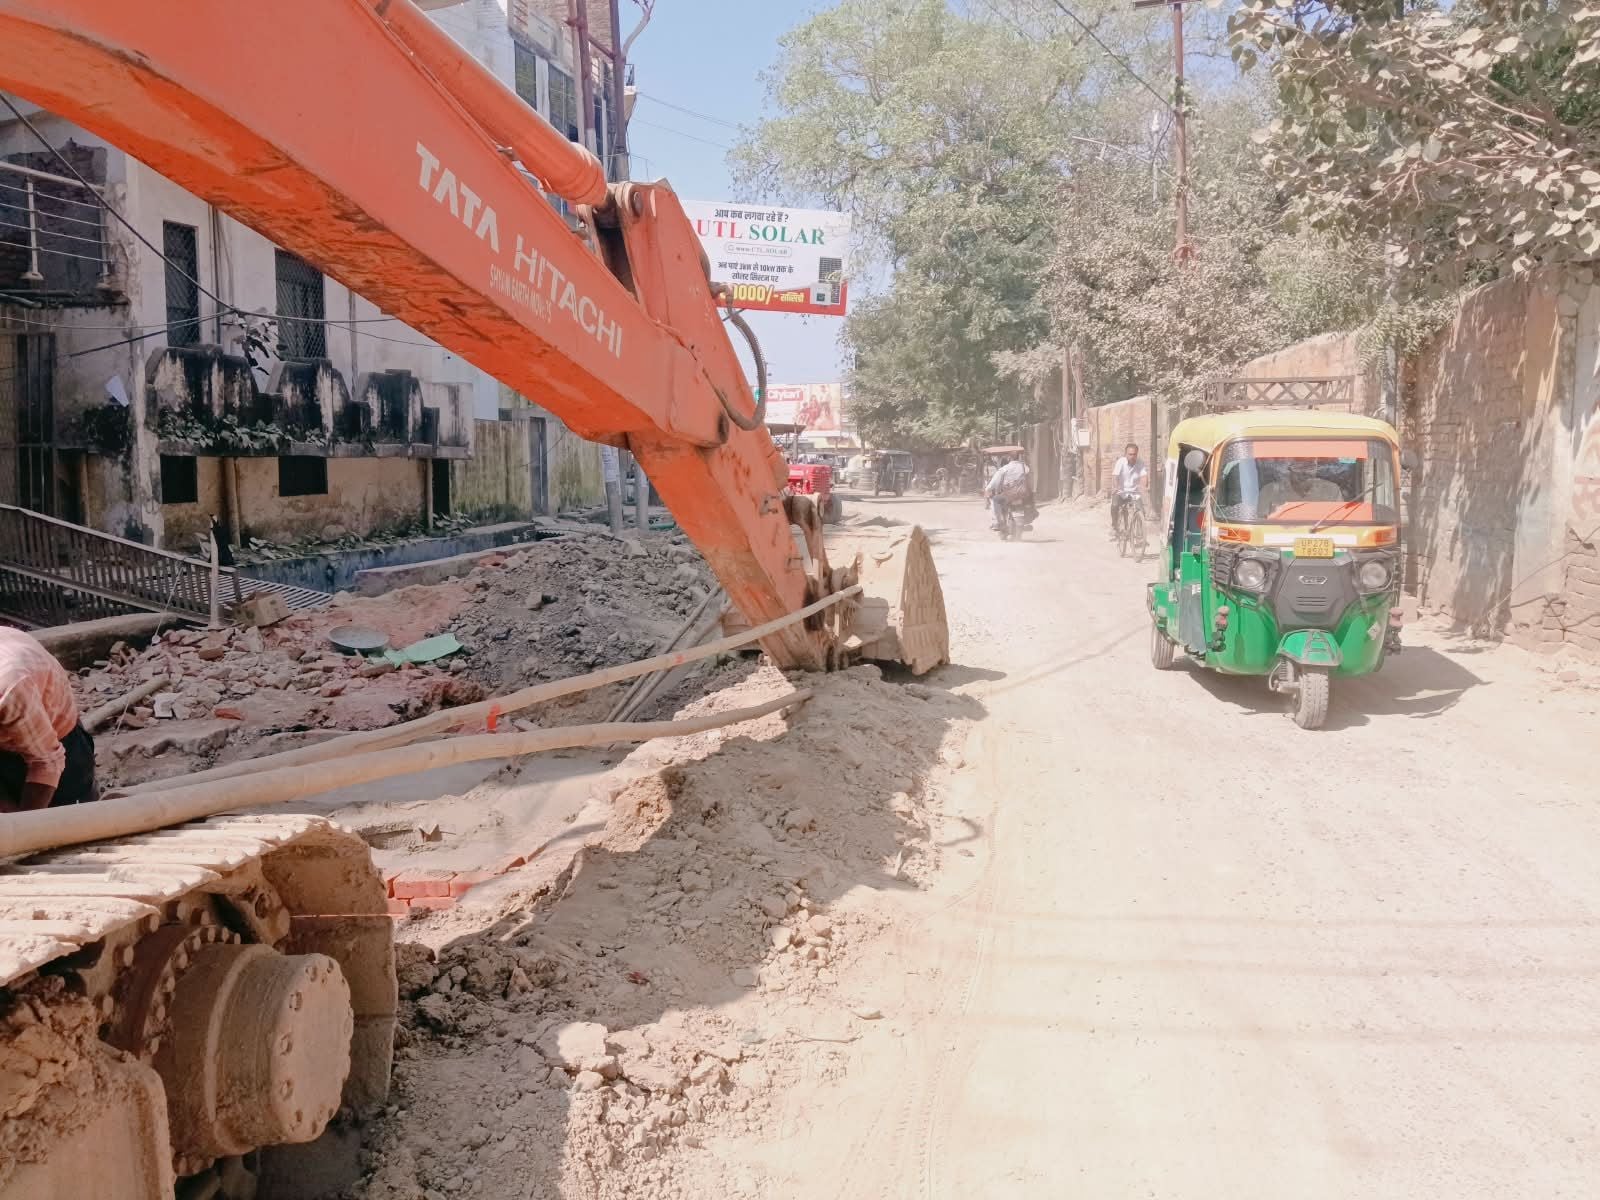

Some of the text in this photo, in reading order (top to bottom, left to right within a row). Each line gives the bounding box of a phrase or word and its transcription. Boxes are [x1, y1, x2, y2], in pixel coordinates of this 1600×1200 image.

[715, 208, 728, 218] आप
[696, 219, 825, 245] UTL SOLAR
[416, 141, 623, 358] TATA HITACHI
